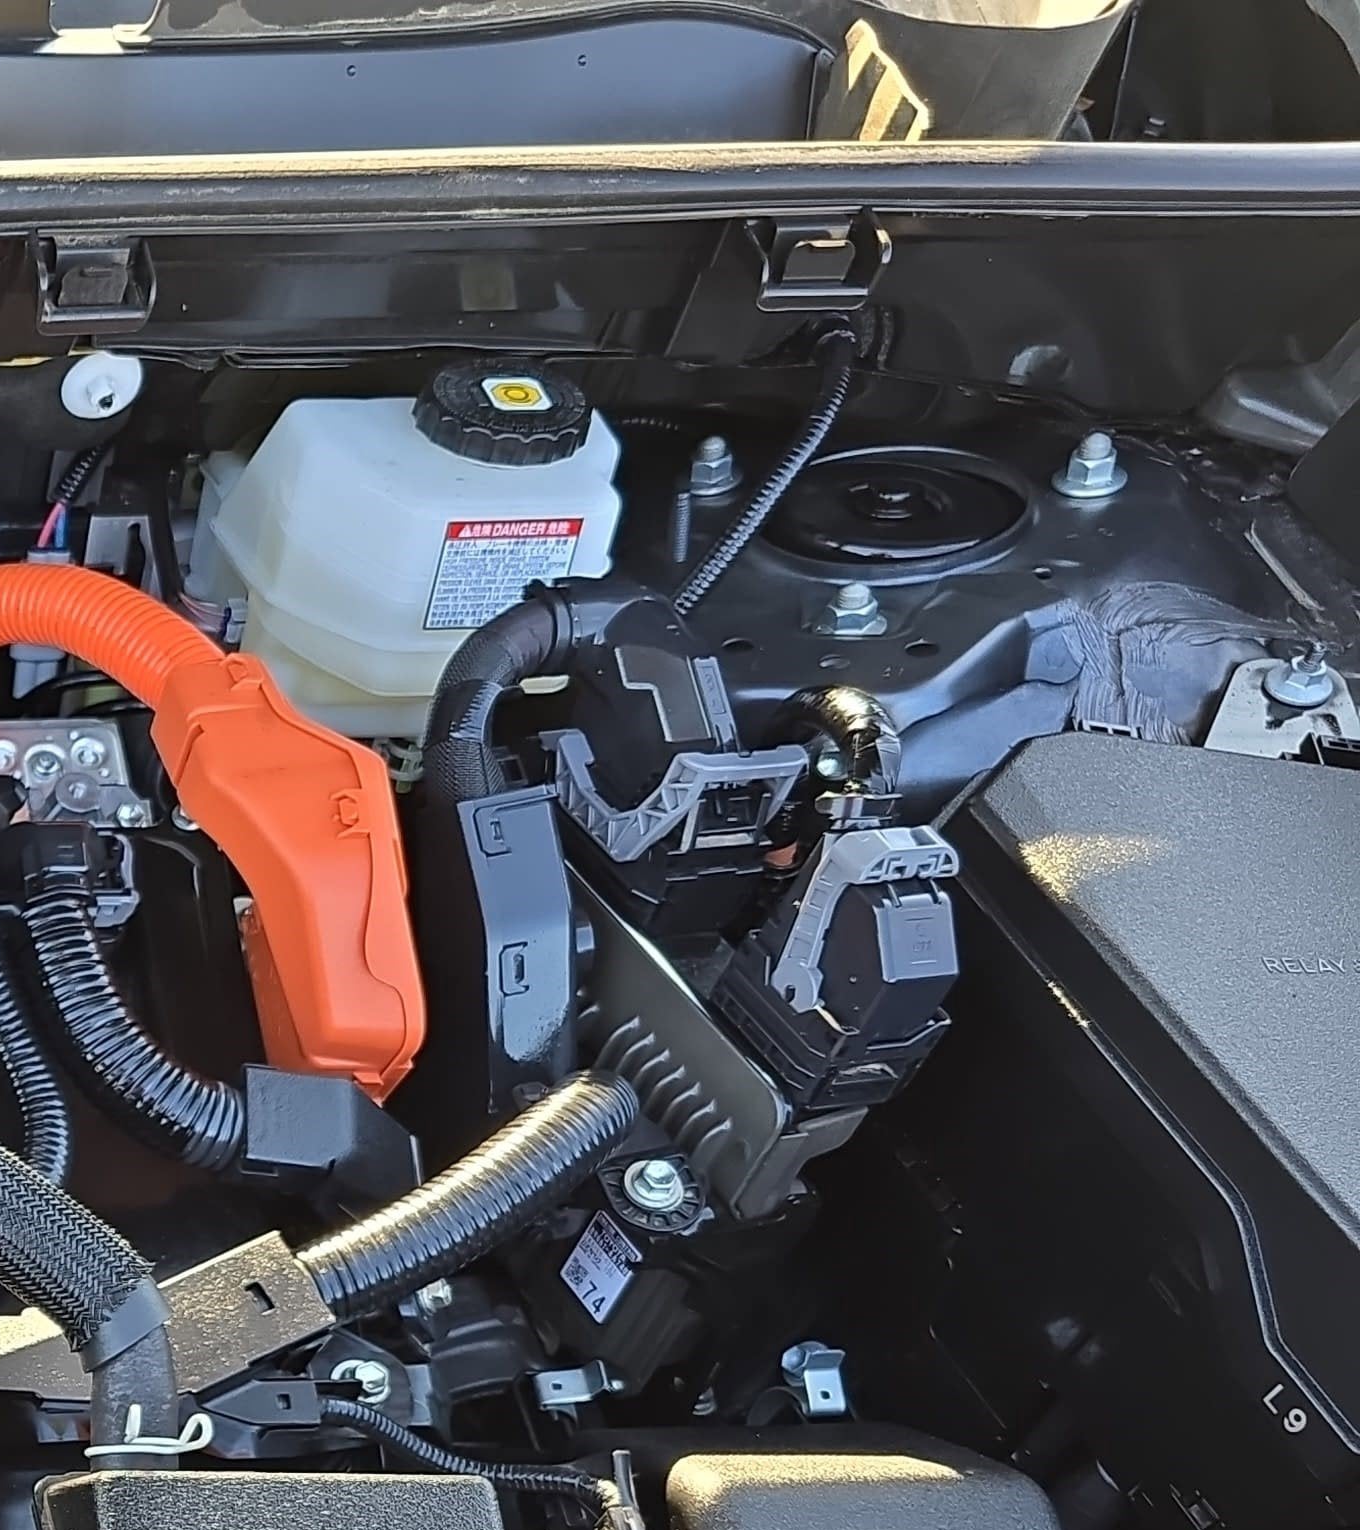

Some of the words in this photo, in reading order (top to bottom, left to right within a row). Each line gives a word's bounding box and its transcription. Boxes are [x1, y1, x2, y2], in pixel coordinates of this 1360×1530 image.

[492, 523, 545, 537] DANGER
[1260, 956, 1346, 975] RELAY
[582, 1279, 607, 1314] 74
[1263, 1383, 1307, 1433] L9
